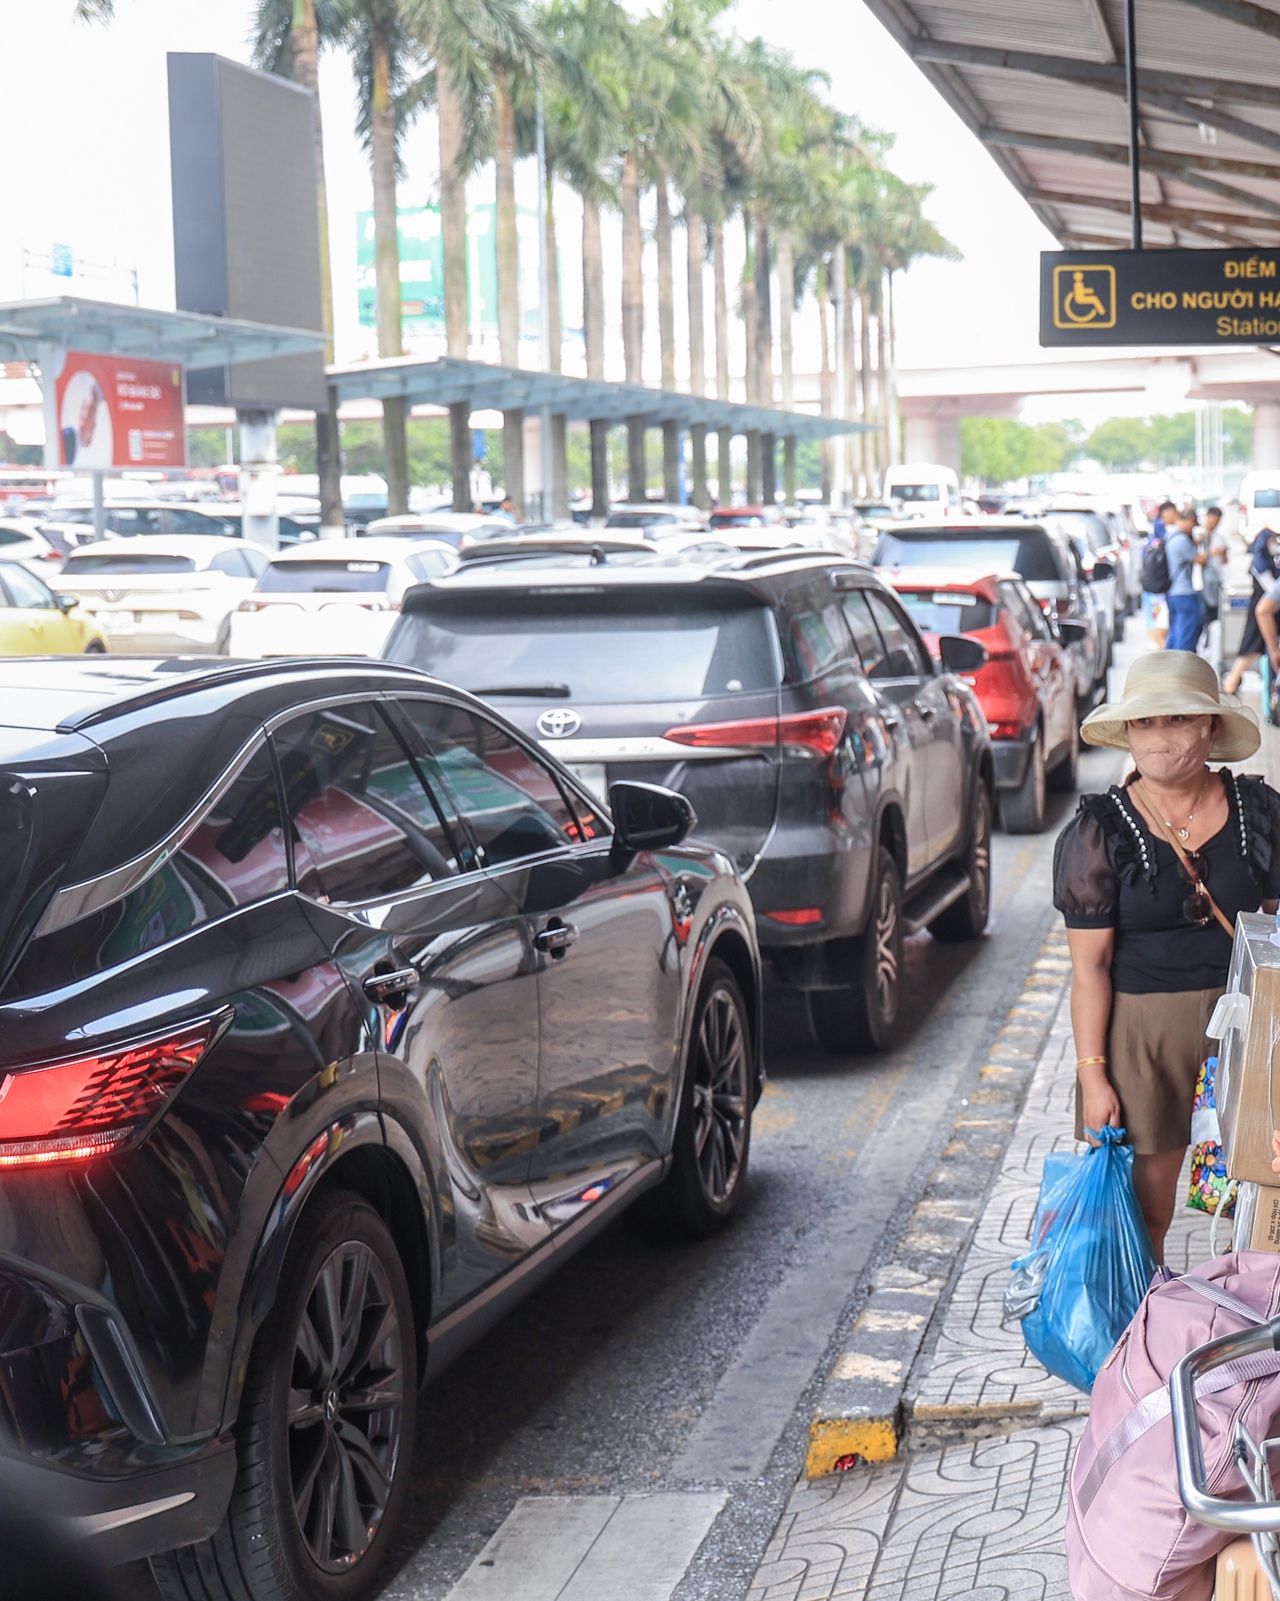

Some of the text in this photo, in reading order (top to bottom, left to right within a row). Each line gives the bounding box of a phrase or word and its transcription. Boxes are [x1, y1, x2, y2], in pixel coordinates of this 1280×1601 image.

[1224, 255, 1276, 278] ĐIỂM
[1131, 292, 1177, 310] CHO
[1183, 287, 1254, 309] NGƯỜI
